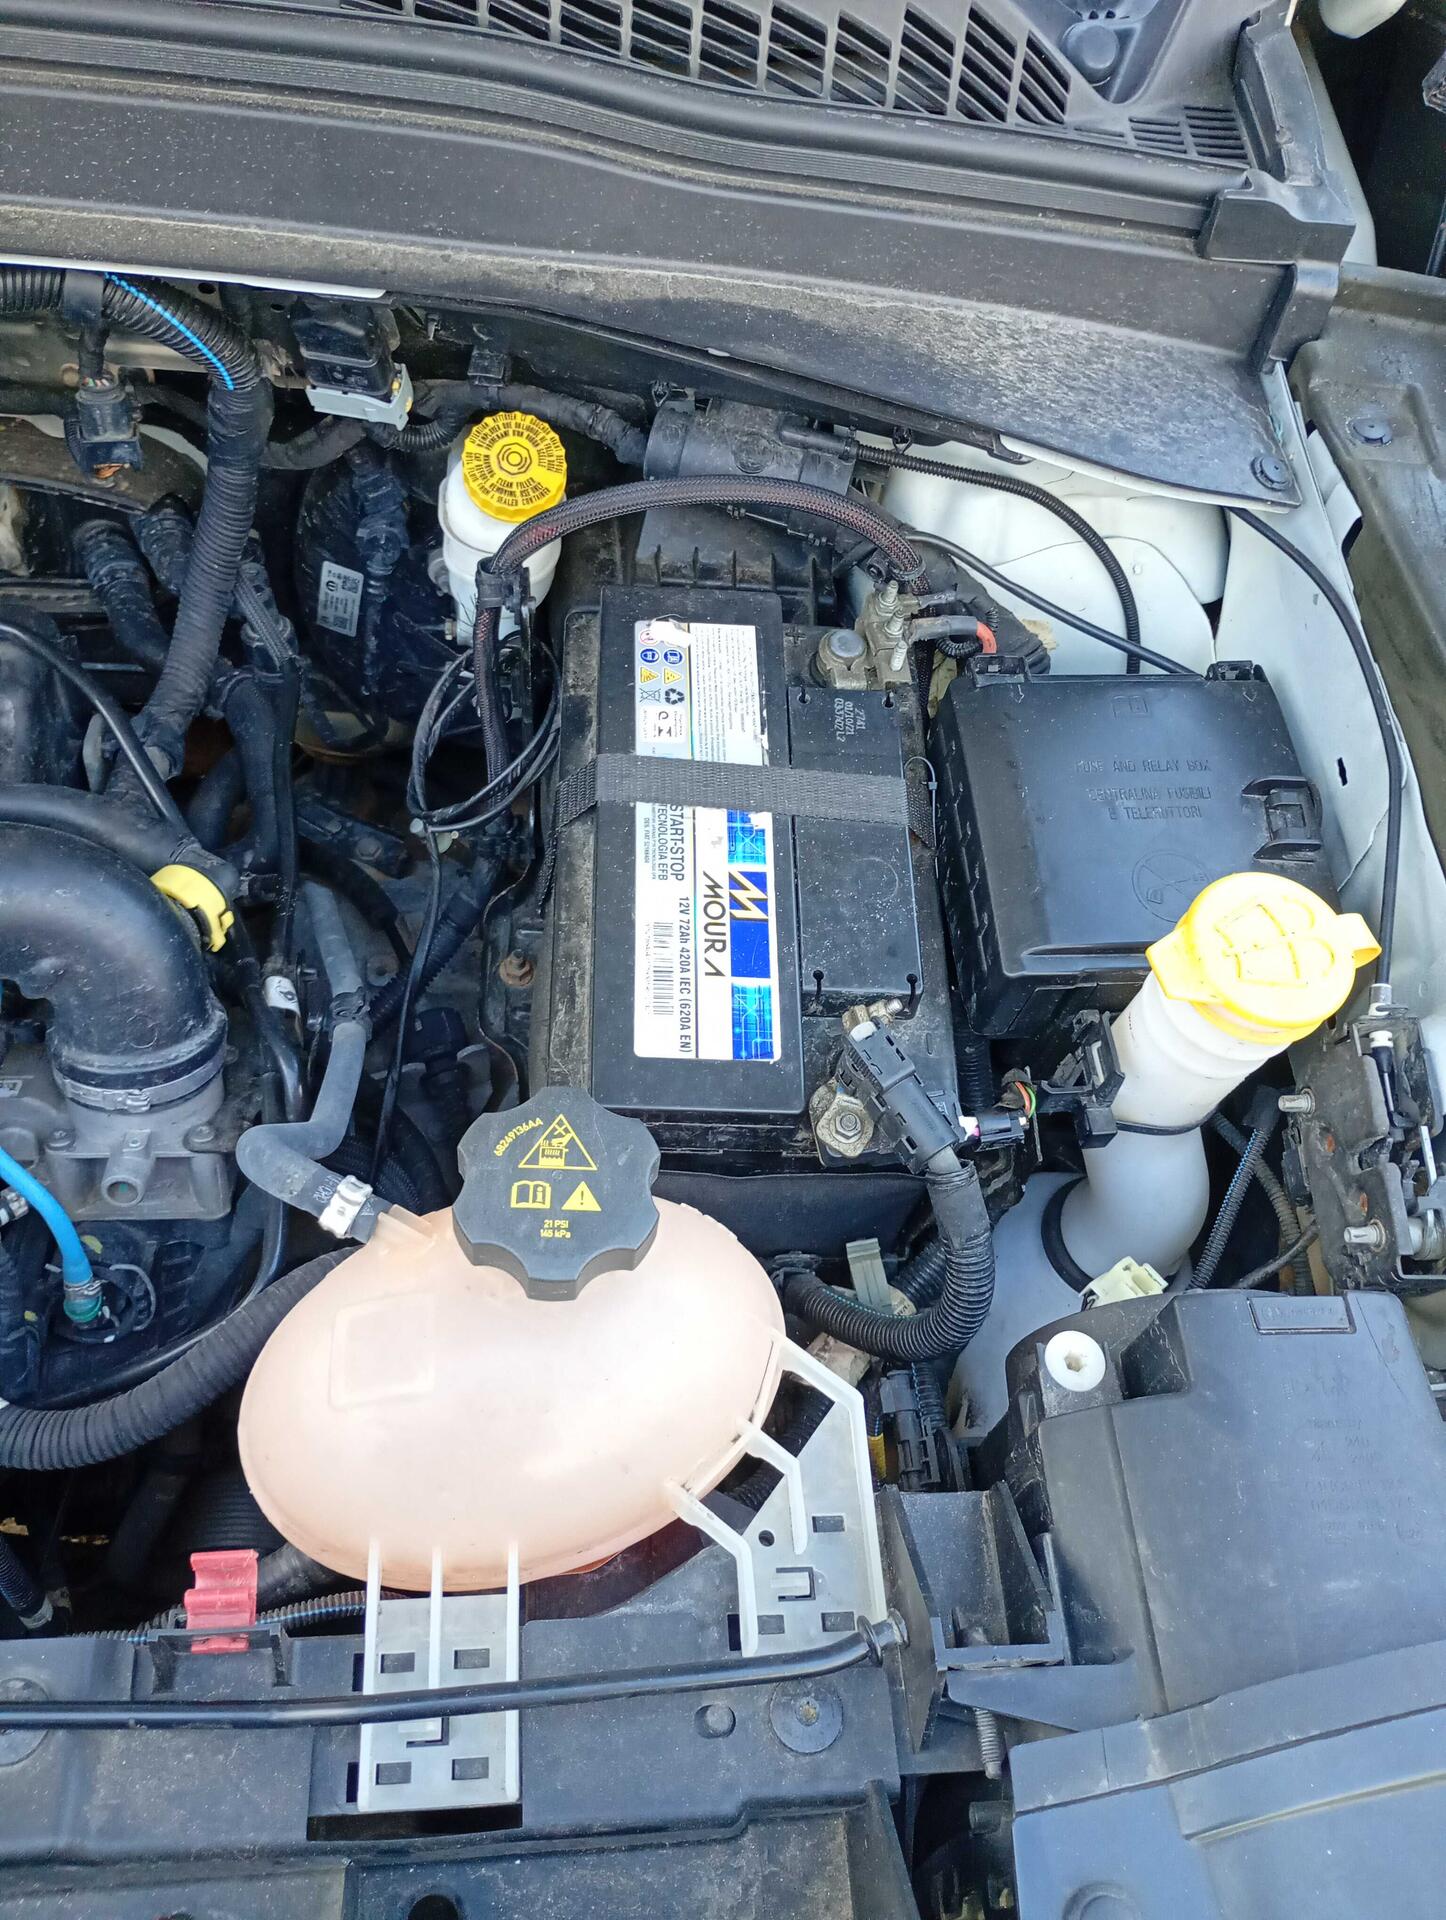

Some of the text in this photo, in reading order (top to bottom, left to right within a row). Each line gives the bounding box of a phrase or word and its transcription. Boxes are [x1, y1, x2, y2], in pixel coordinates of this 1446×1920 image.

[496, 478, 512, 487] CLEAN
[517, 477, 535, 488] FILLER
[522, 487, 550, 504] CONTAINER
[1113, 760, 1136, 772] AND
[1143, 760, 1180, 772] RELAY
[1088, 788, 1160, 801] CENTRALINA
[657, 803, 668, 881] TECNOLOGIA EFB
[669, 804, 685, 882] START-STOP
[703, 871, 726, 977] MOURA
[678, 897, 693, 1053] 12V 72Ah 420A IEC (620A EN)
[493, 1117, 543, 1157] 68249136AA
[544, 1219, 569, 1228] 21 PSI
[554, 1229, 571, 1238] kPa
